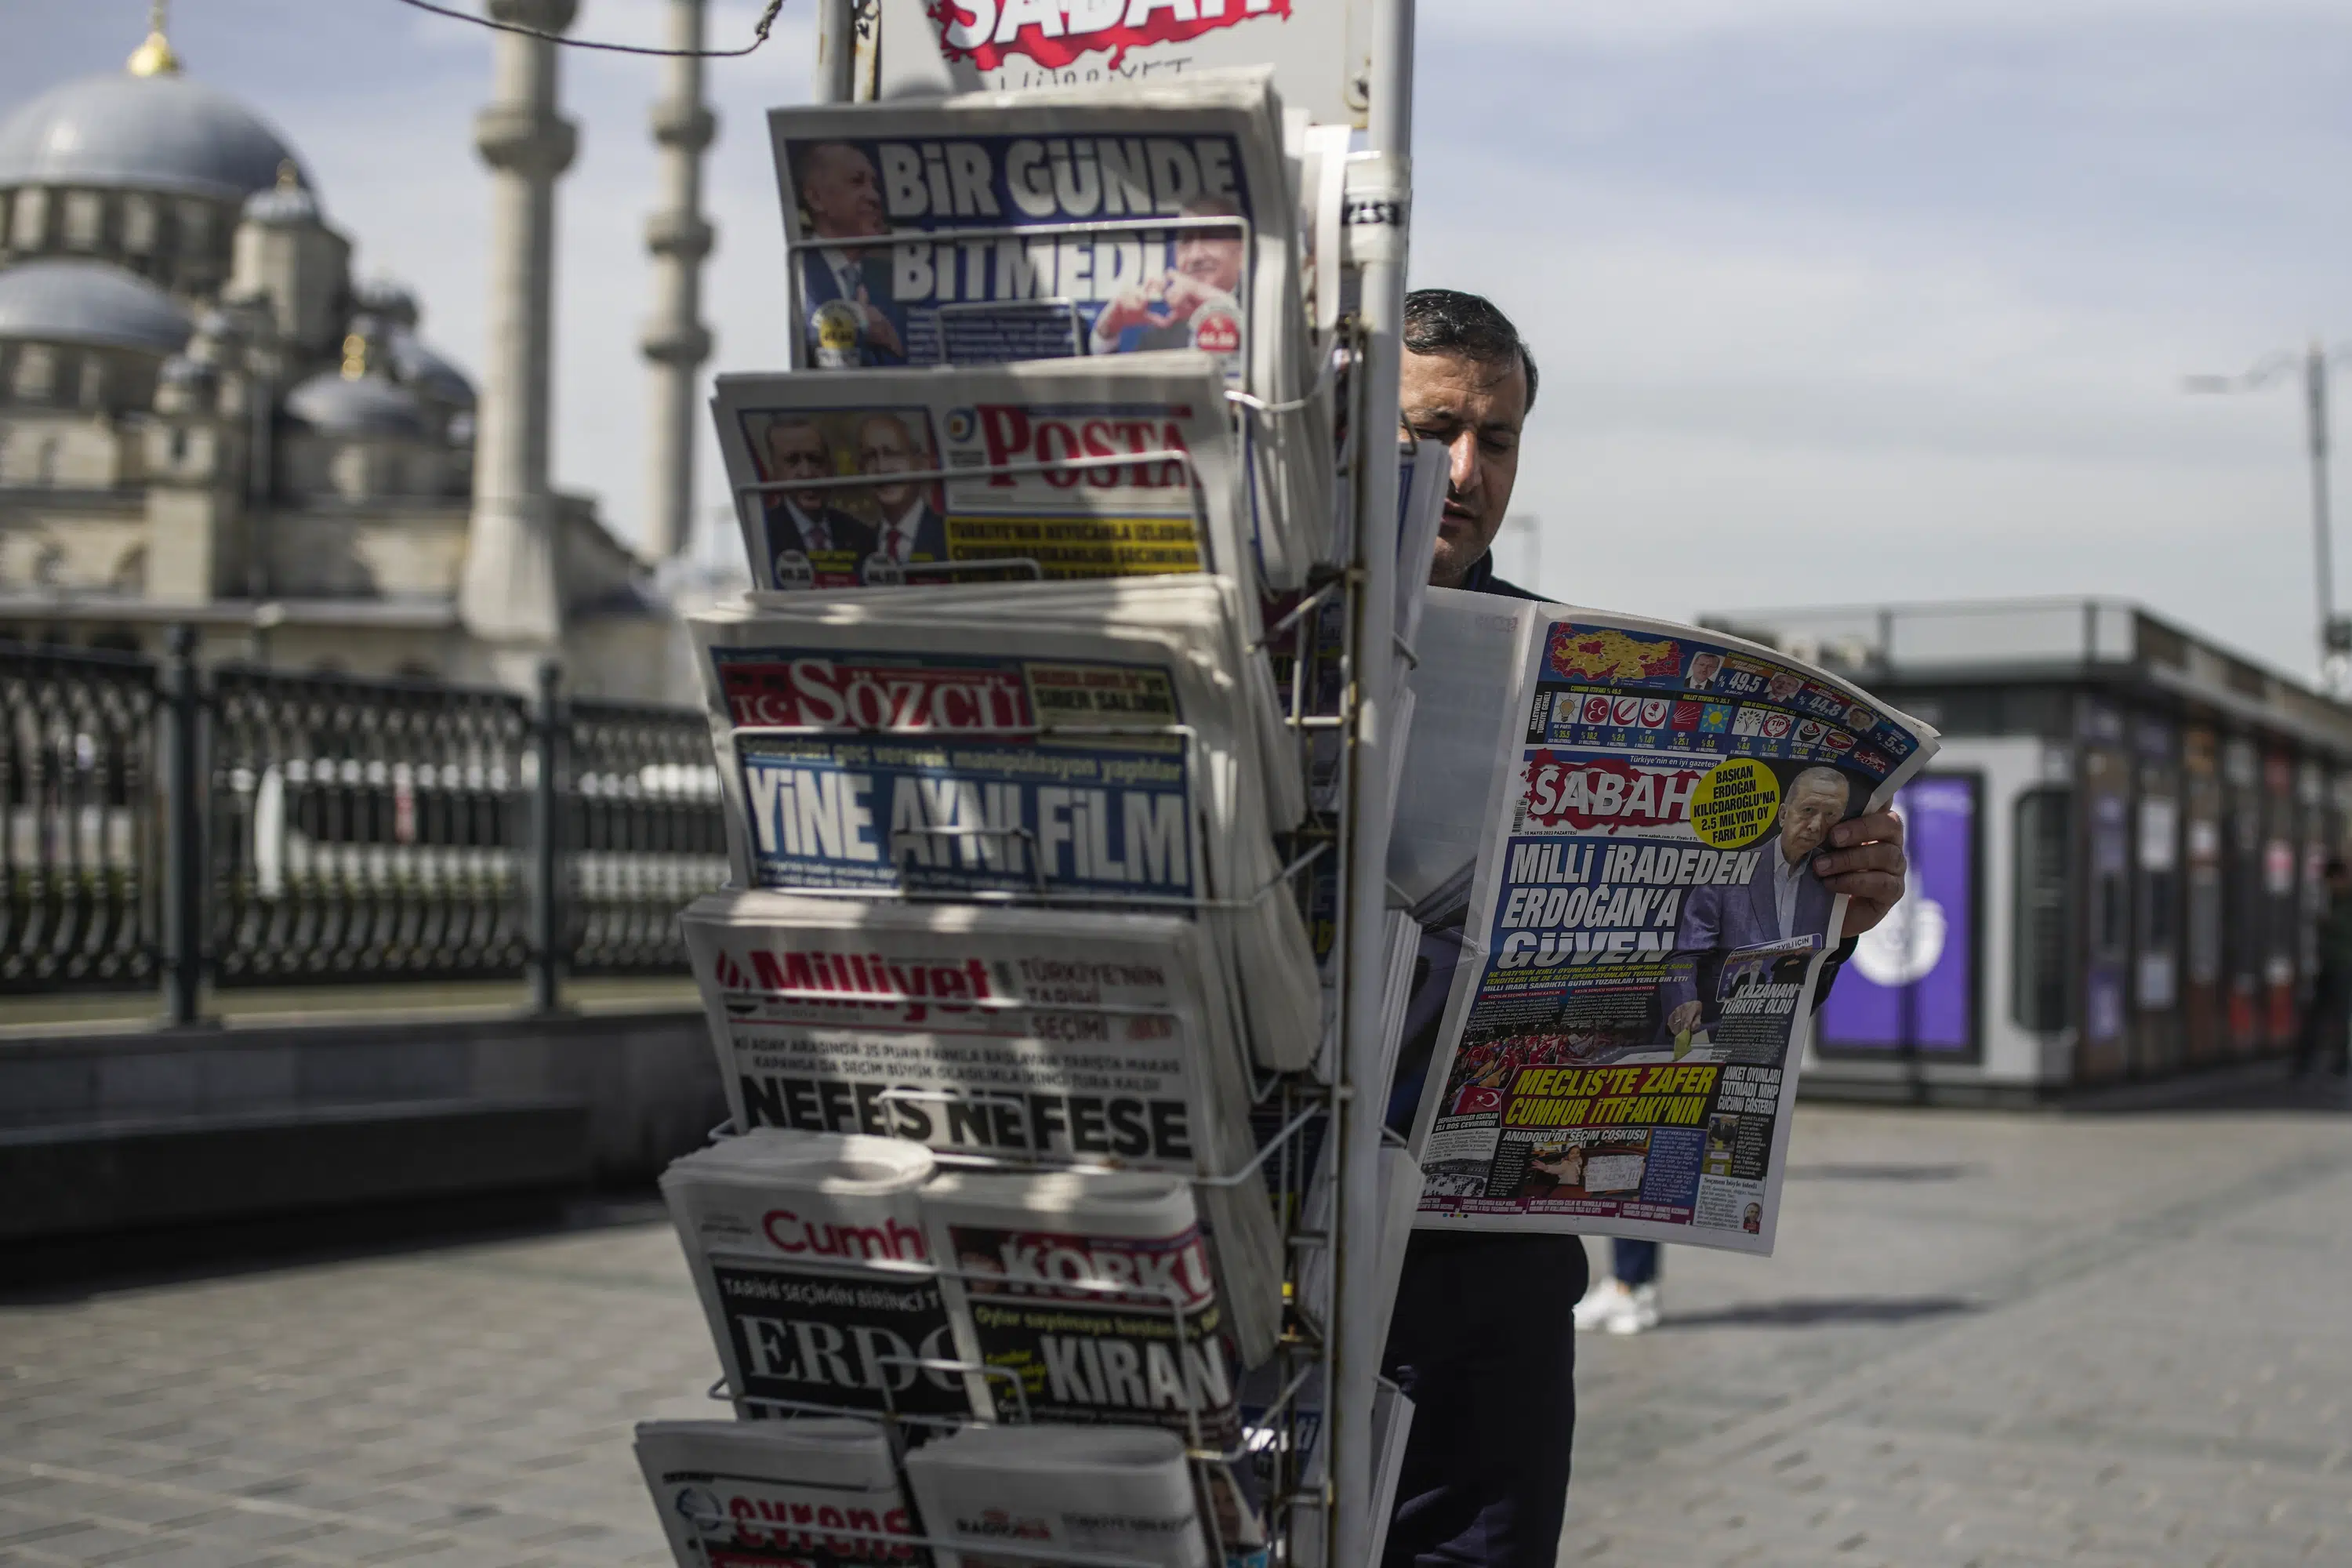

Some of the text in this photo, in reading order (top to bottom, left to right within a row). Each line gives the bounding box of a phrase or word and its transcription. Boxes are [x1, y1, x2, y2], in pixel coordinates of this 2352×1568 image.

[1005, 137, 1245, 218] GÜNDE
[977, 404, 1201, 488] POSTA
[1729, 671, 1764, 693] 49.5
[1809, 696, 1842, 717] 44.8
[1884, 736, 1907, 755] 5.3
[1630, 755, 1668, 765] Türkiye'nin
[1679, 758, 1688, 767] iyi
[1689, 760, 1718, 769] gazetesi
[1529, 770, 1700, 821] SABAH
[892, 775, 1029, 874] AYNI
[1701, 817, 1717, 831] 2.5
[1757, 806, 1769, 820] OY
[1712, 823, 1758, 844] FARK ATTI
[1501, 884, 1682, 928] ERDOĞAN'A
[1497, 931, 1675, 970] GÜVEN
[750, 950, 1001, 1022] Milliyet
[1529, 981, 1566, 989] SANDIKTA
[1734, 982, 1799, 999] KAZANAN
[1764, 998, 1795, 1014] OLDU
[1512, 1066, 1718, 1097] MECLİS'TE ZAFER
[1722, 1065, 1781, 1084] ANKET OYUNLARI
[1721, 1080, 1780, 1099] TUTMADI MHP
[740, 1074, 1193, 1159] NEFES NEFESE
[1505, 1098, 1594, 1126] CUMHUR
[1502, 1130, 1566, 1143] ANADOLU'DA
[762, 1210, 926, 1260] Cumh
[1039, 1334, 1232, 1411] KIRAN
